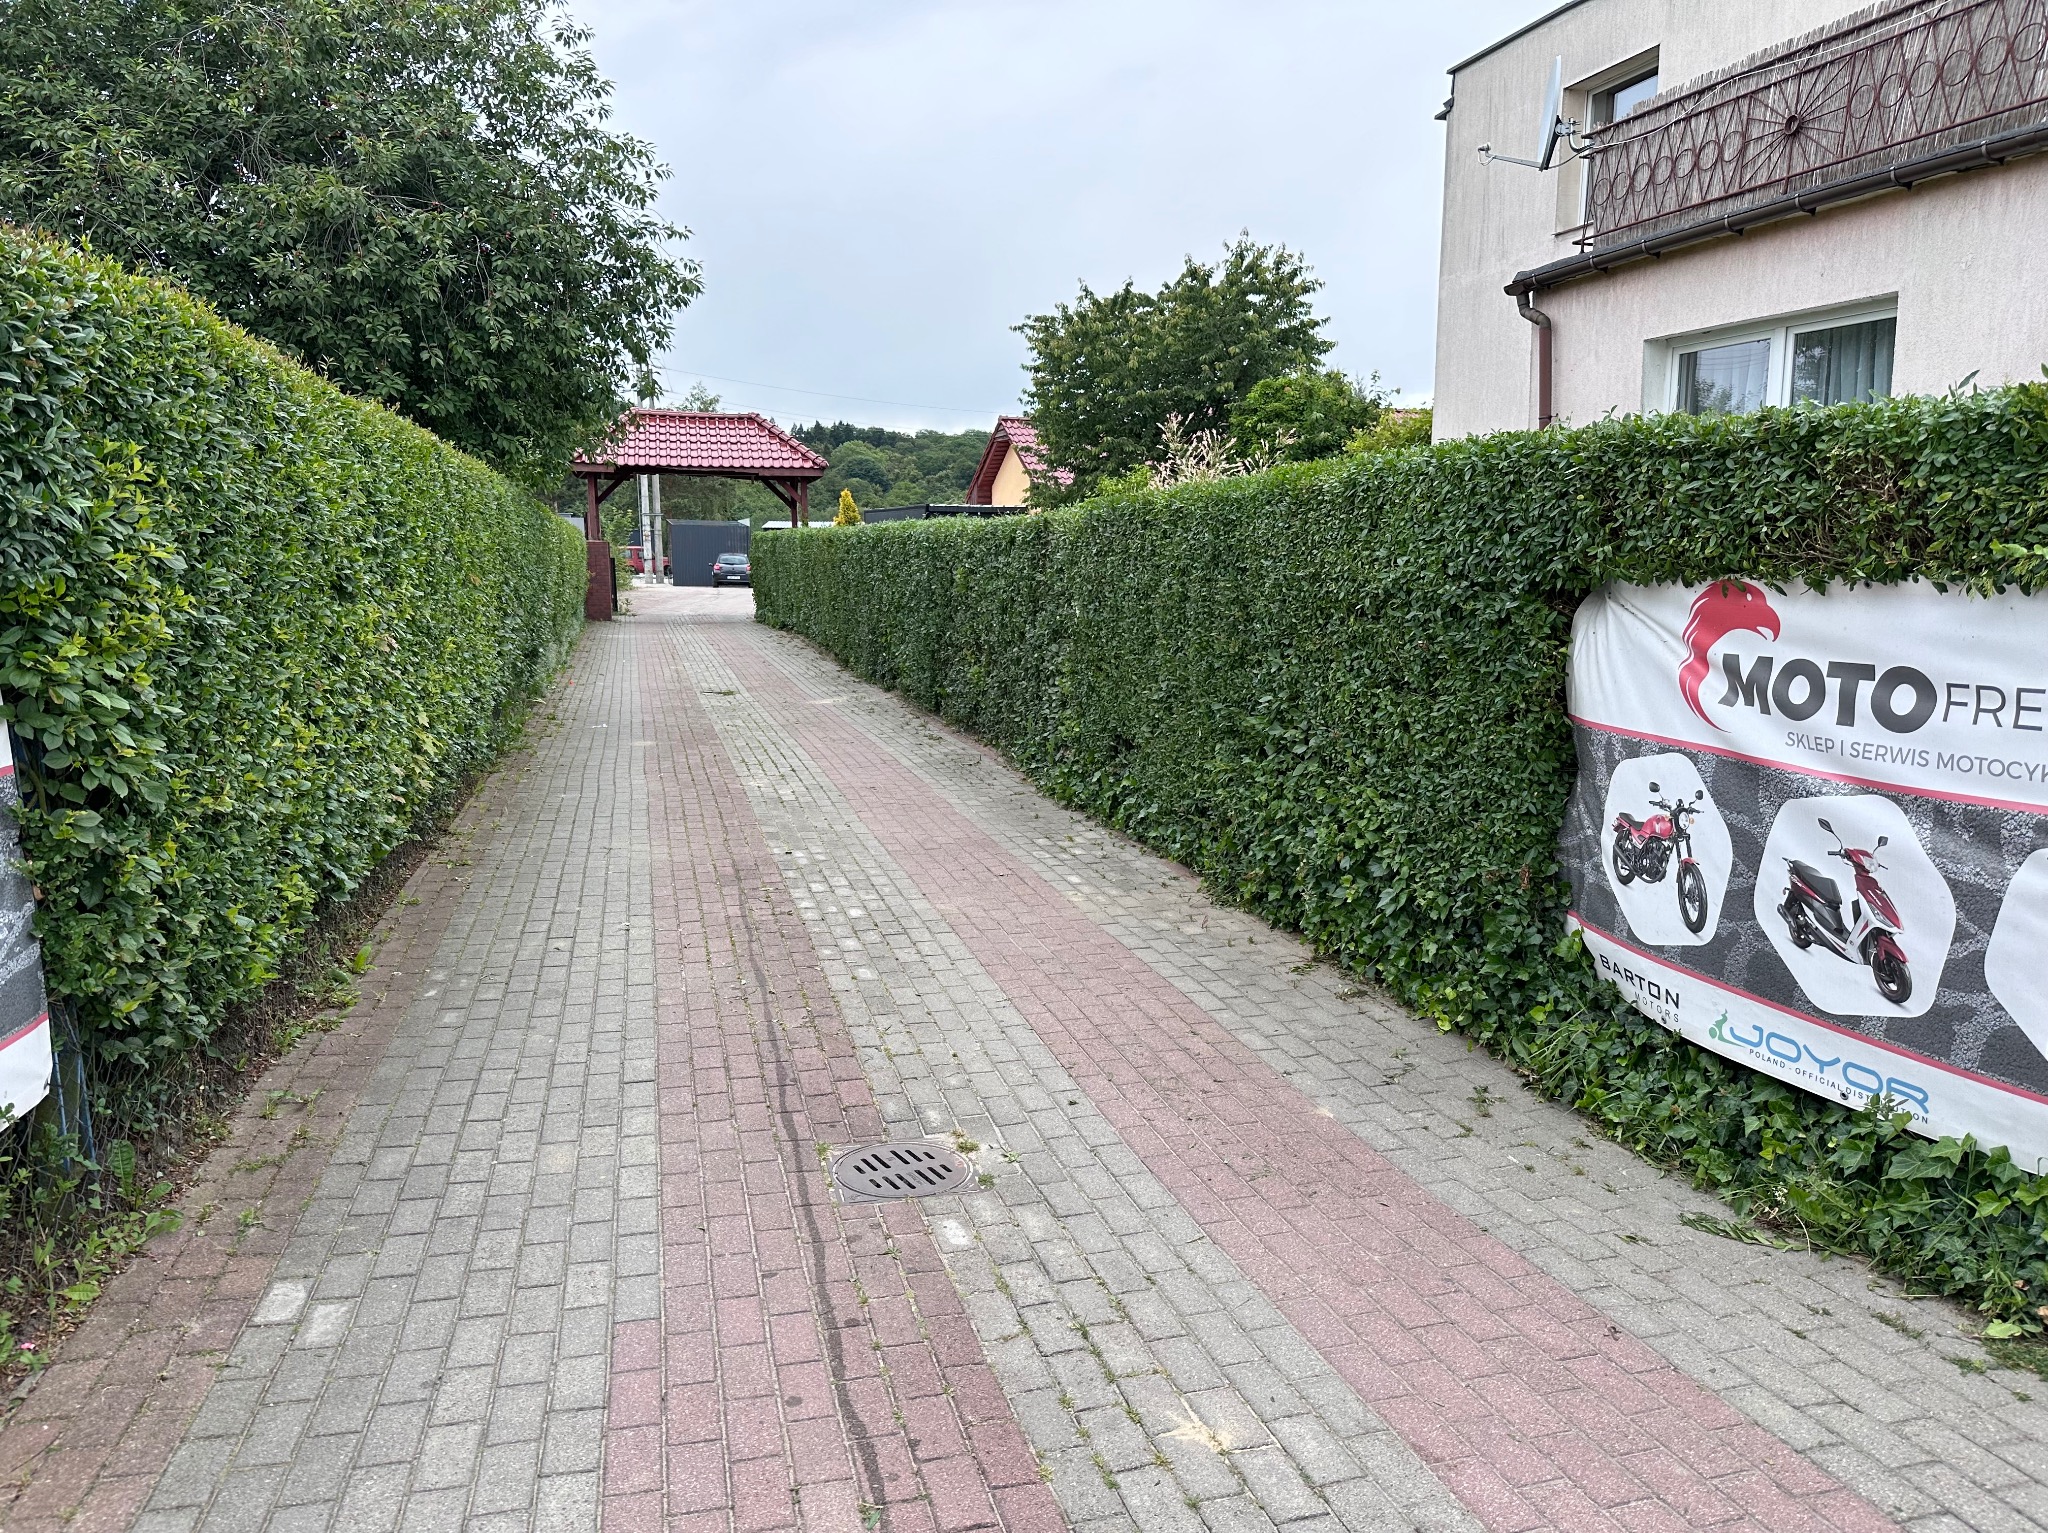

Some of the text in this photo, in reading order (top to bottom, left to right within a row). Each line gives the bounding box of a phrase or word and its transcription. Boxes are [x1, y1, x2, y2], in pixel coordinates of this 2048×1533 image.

[1785, 731, 1835, 754] SKLEP
[1849, 741, 1930, 768] SERWIS
[1599, 953, 1680, 1009] BARTON
[1634, 991, 1679, 1023] MOTORS
[1729, 1024, 1929, 1114] JOYOR
[1749, 1048, 1786, 1069] POLAND
[1794, 1067, 1843, 1093] OFFICIAL
